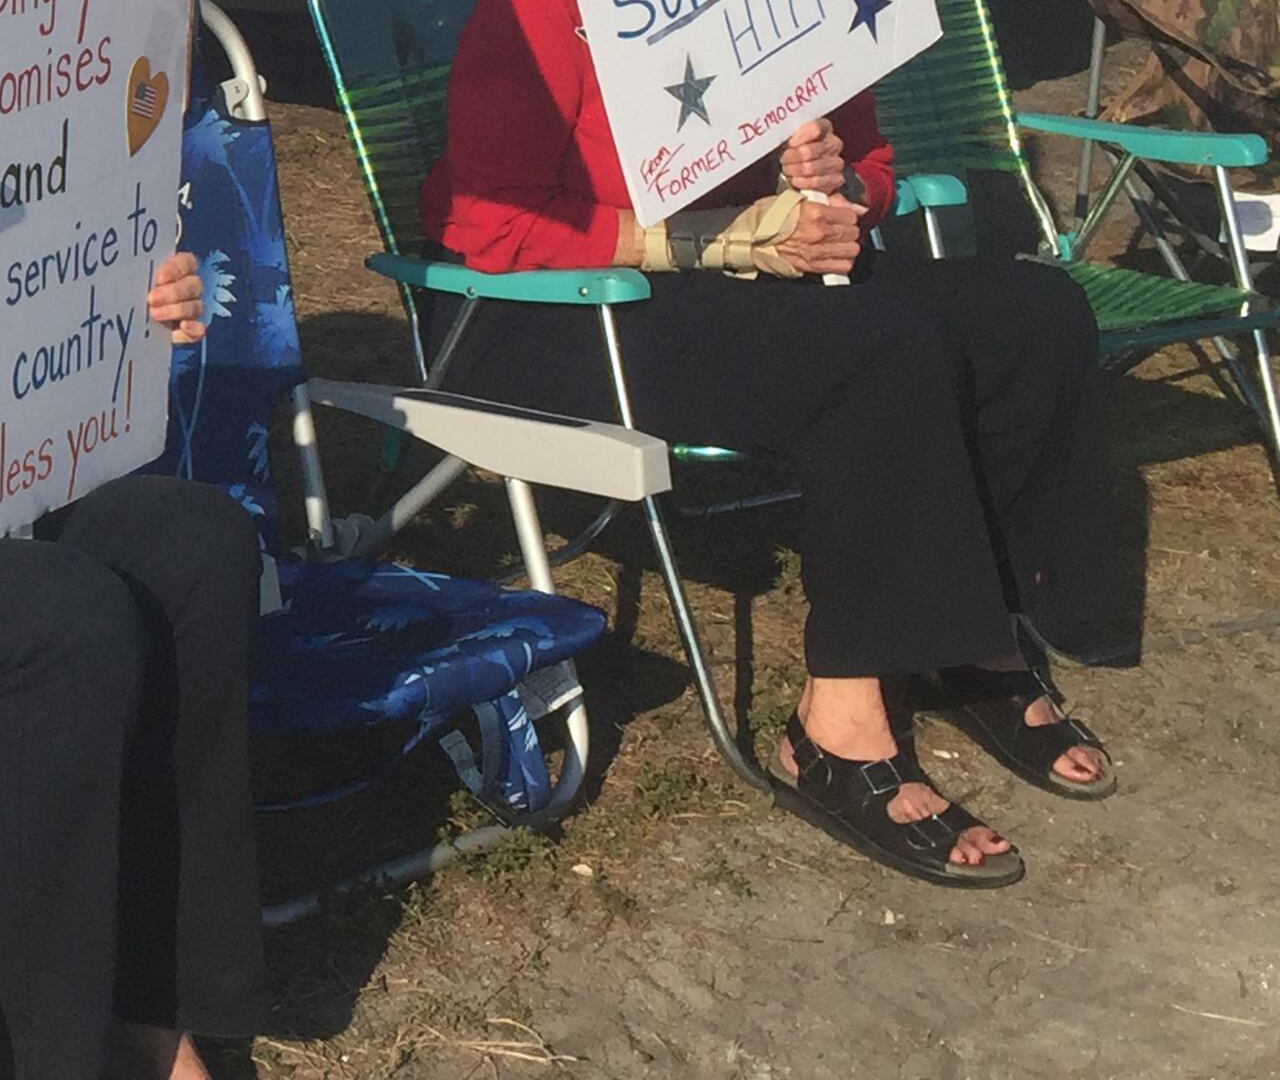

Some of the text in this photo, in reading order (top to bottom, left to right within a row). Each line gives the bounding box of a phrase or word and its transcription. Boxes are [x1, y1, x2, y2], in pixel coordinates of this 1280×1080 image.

[0, 118, 69, 209] and
[737, 62, 834, 145] DEMOCRAT
[6, 221, 119, 306] service
[127, 182, 157, 258] to
[13, 260, 155, 402] country!
[66, 360, 134, 501] you!
